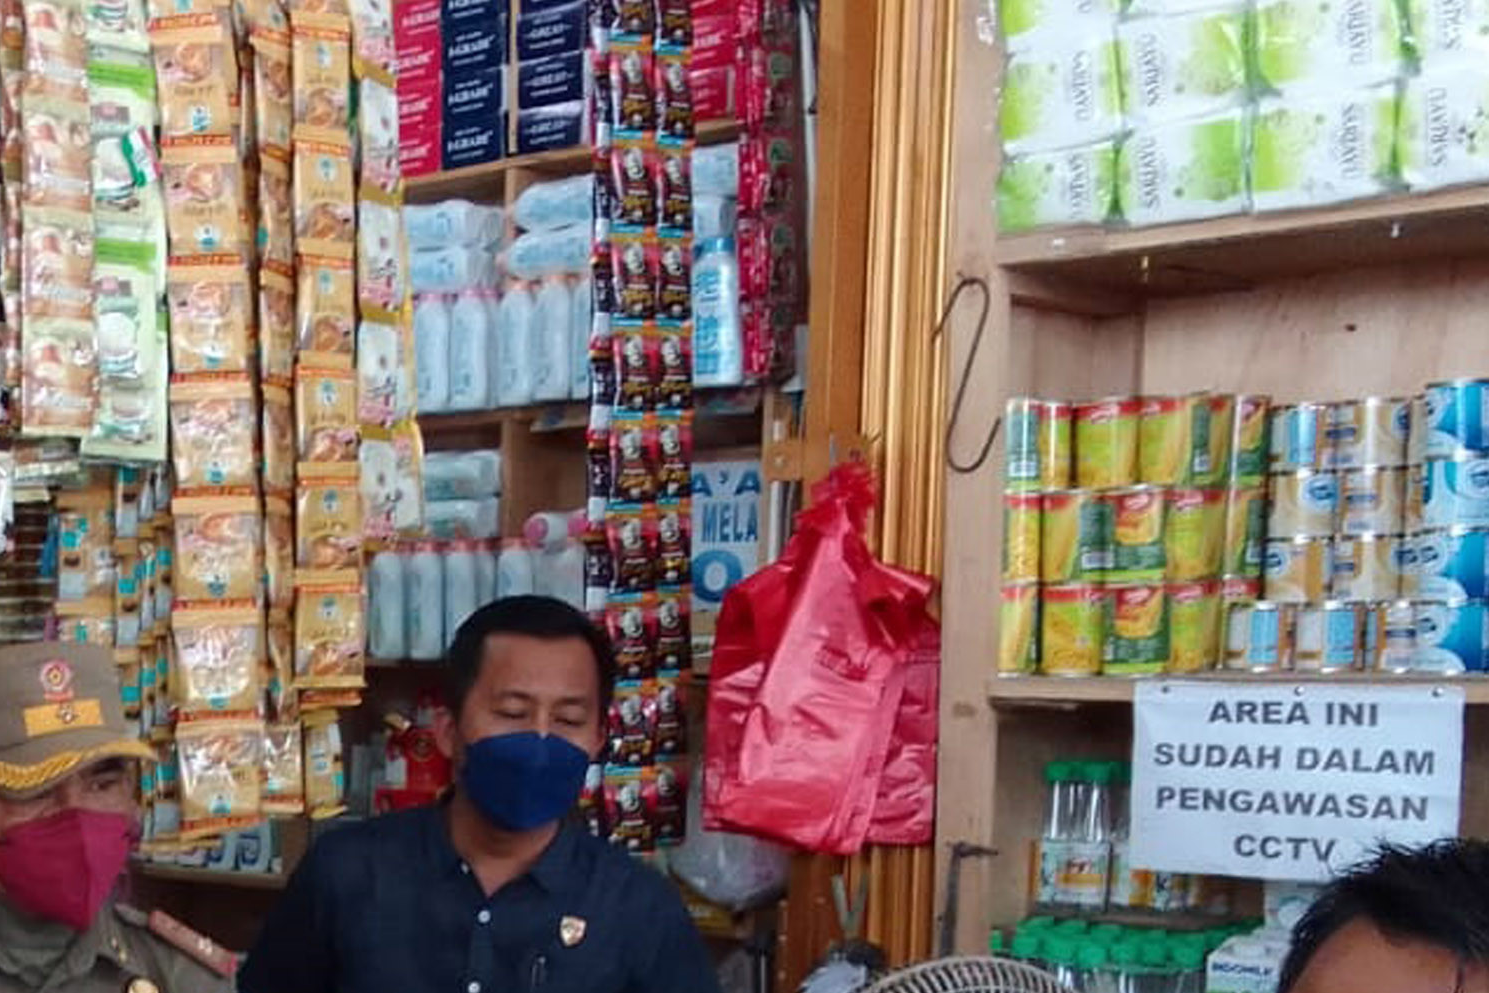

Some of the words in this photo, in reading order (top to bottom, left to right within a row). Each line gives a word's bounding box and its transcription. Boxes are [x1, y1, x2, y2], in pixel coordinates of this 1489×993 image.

[1208, 700, 1311, 726] AREA
[1325, 702, 1379, 728] INI
[1154, 742, 1281, 771] SUDAH
[1296, 747, 1435, 776] DALAM
[1156, 786, 1429, 822] PENGAWASAN
[1234, 833, 1337, 863] CCTV
